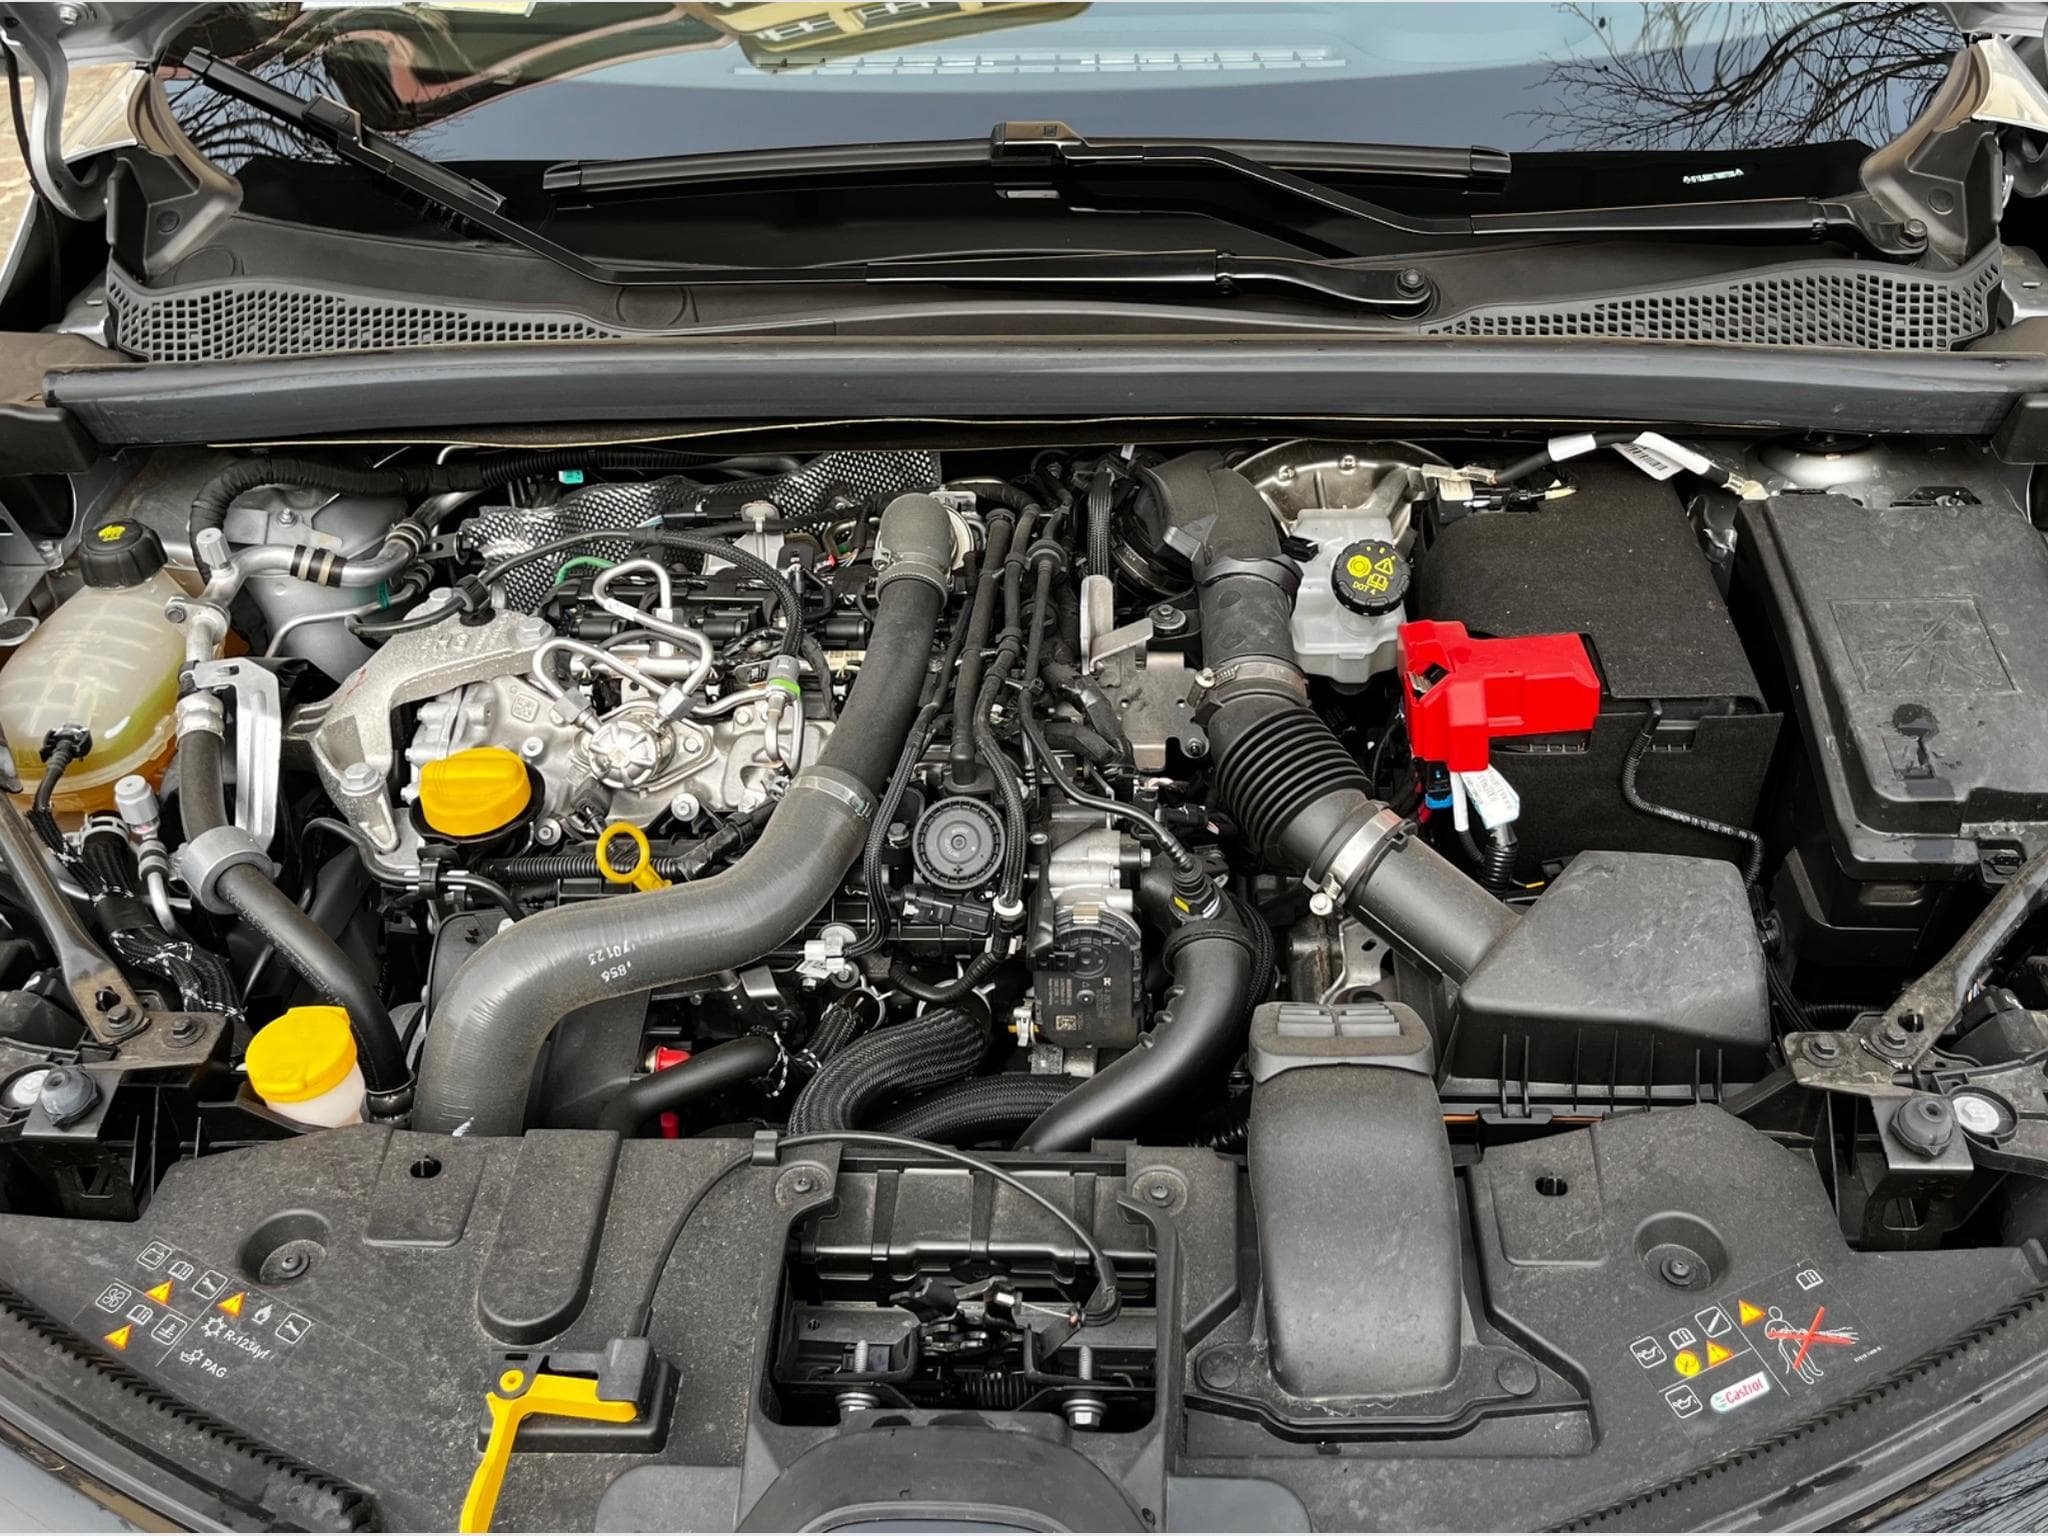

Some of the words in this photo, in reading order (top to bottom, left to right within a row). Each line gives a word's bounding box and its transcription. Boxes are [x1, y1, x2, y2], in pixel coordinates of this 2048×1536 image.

[1352, 580, 1369, 592] DOT
[223, 1329, 272, 1360] R-1234yf
[200, 1358, 228, 1378] PAG
[1723, 1377, 1765, 1405] Castrol
